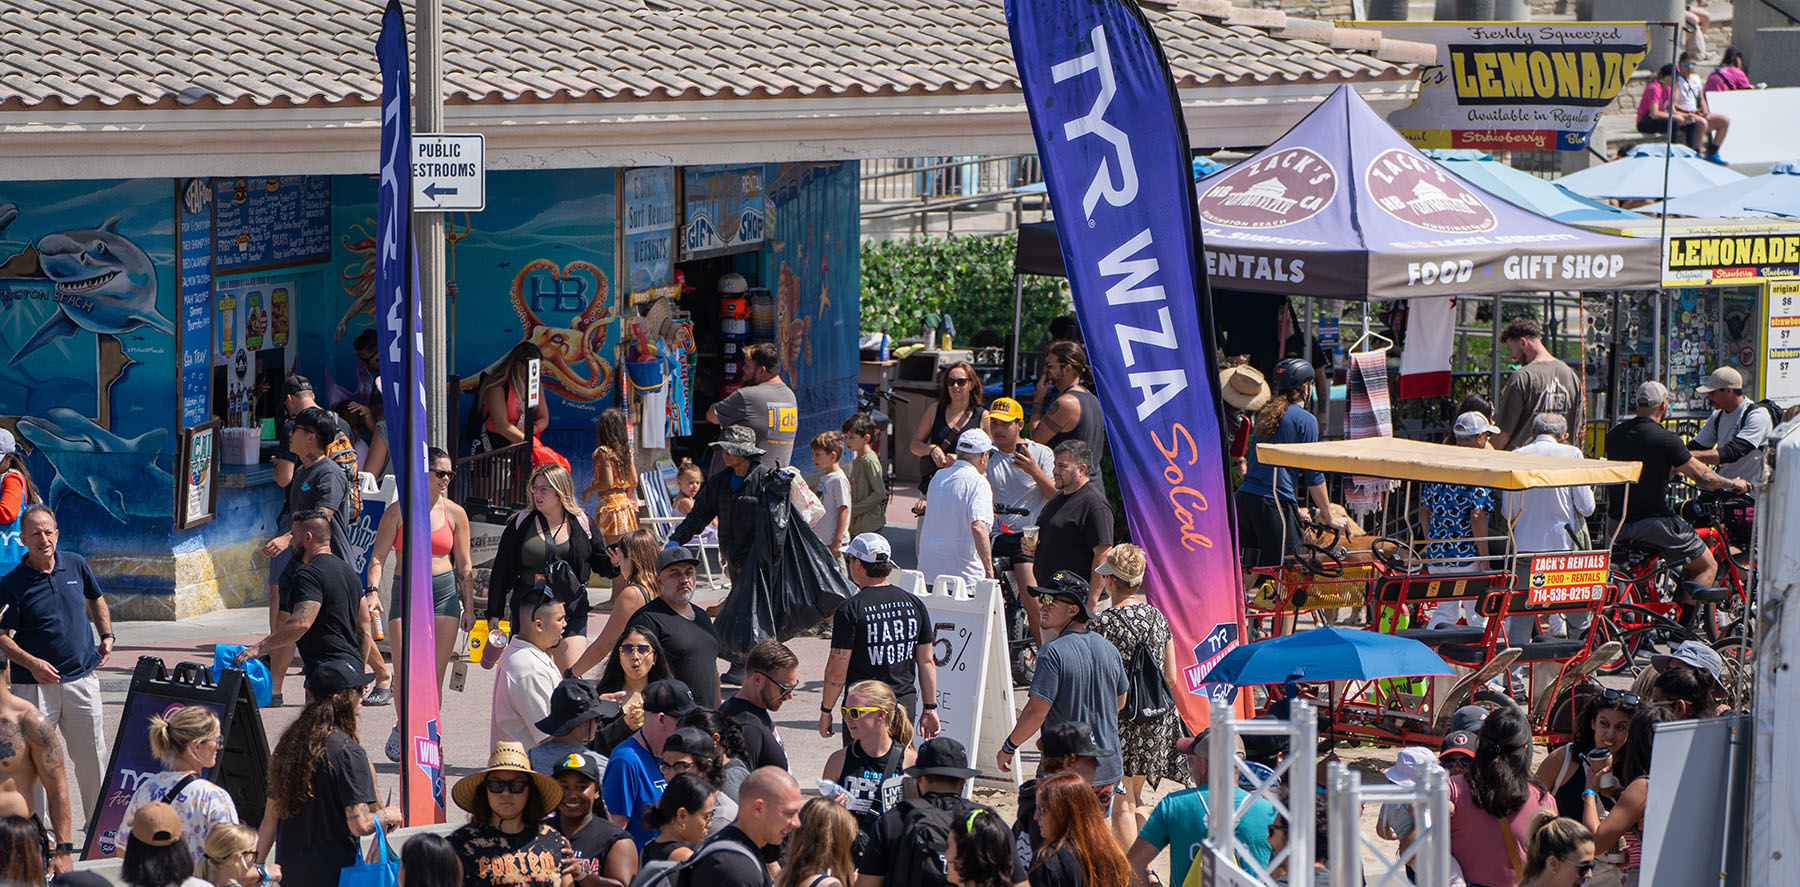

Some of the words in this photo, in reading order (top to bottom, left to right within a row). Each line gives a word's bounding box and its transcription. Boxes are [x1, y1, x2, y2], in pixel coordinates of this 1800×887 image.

[1467, 26, 1533, 45] Freshly
[1539, 26, 1624, 44] Squeezed
[1468, 108, 1530, 123] Available
[1534, 110, 1547, 121] in
[1461, 131, 1547, 147] Strawberry
[1565, 132, 1585, 145] Blu
[419, 143, 461, 158] PUBLIC
[413, 162, 476, 178] ESTROOMS
[1248, 151, 1330, 186] ZACK'S
[1371, 151, 1447, 184] ZACK'S
[1207, 185, 1234, 198] HB
[1299, 195, 1325, 211] CA
[1379, 195, 1407, 212] HB
[629, 204, 646, 229] Surf
[648, 202, 674, 226] Rentals
[1051, 24, 1140, 216] TYR
[1097, 227, 1190, 423] WZA
[688, 218, 715, 250] GIFT
[739, 212, 764, 242] SHOP
[634, 237, 667, 264] WETSUITS
[1669, 236, 1800, 267] LEMONADE
[1204, 251, 1305, 284] ENTALS
[1407, 259, 1474, 287] FOOD
[1503, 254, 1558, 281] GIFT
[1562, 254, 1625, 279] SHOP
[1675, 270, 1703, 282] Original
[1715, 269, 1754, 279] Strawberry
[1760, 267, 1795, 277] Blueberry
[530, 274, 589, 313] HB
[1772, 284, 1800, 294] original
[54, 291, 94, 313] BEACH
[1780, 329, 1790, 339] $7
[1779, 362, 1789, 372] $7
[1151, 422, 1213, 551] SoCal
[1535, 557, 1565, 571] ZACK'S
[1567, 555, 1605, 570] RENTALS
[1547, 574, 1564, 584] FOOD
[1571, 572, 1601, 583] RENTALS
[1533, 586, 1591, 603] 714-536-0215
[880, 601, 913, 610] OFFICIAL
[865, 610, 902, 622] SPONSOR
[867, 617, 918, 644] HARD
[1208, 627, 1228, 652] TYR
[867, 642, 914, 666] WORK
[120, 769, 157, 791] TY
[884, 785, 903, 798] LIVE
